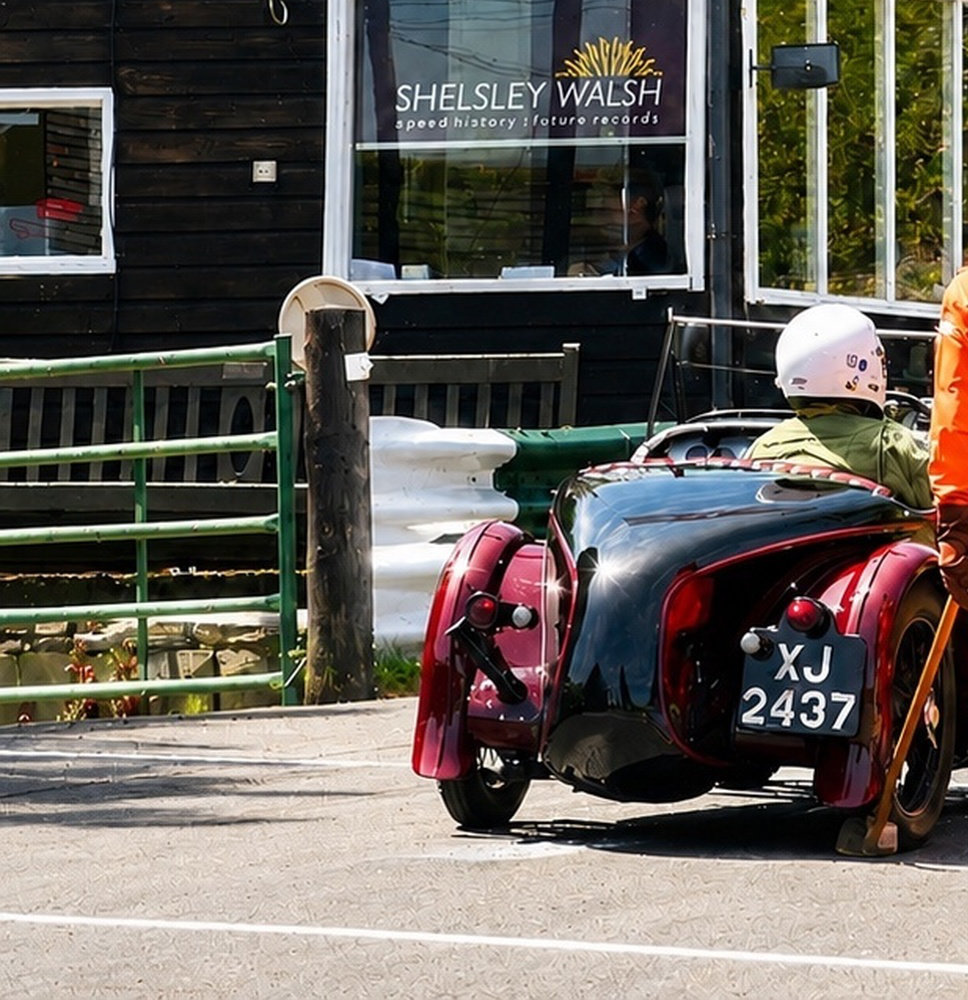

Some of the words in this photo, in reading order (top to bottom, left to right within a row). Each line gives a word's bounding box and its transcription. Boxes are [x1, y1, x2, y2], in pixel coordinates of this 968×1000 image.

[395, 81, 547, 112] SHELSLEY
[556, 78, 662, 108] WALSH
[395, 115, 448, 132] speed
[453, 115, 517, 130] history
[532, 113, 587, 127] future
[592, 110, 660, 126] records
[774, 642, 834, 684] XJ
[741, 686, 857, 731] 2437
